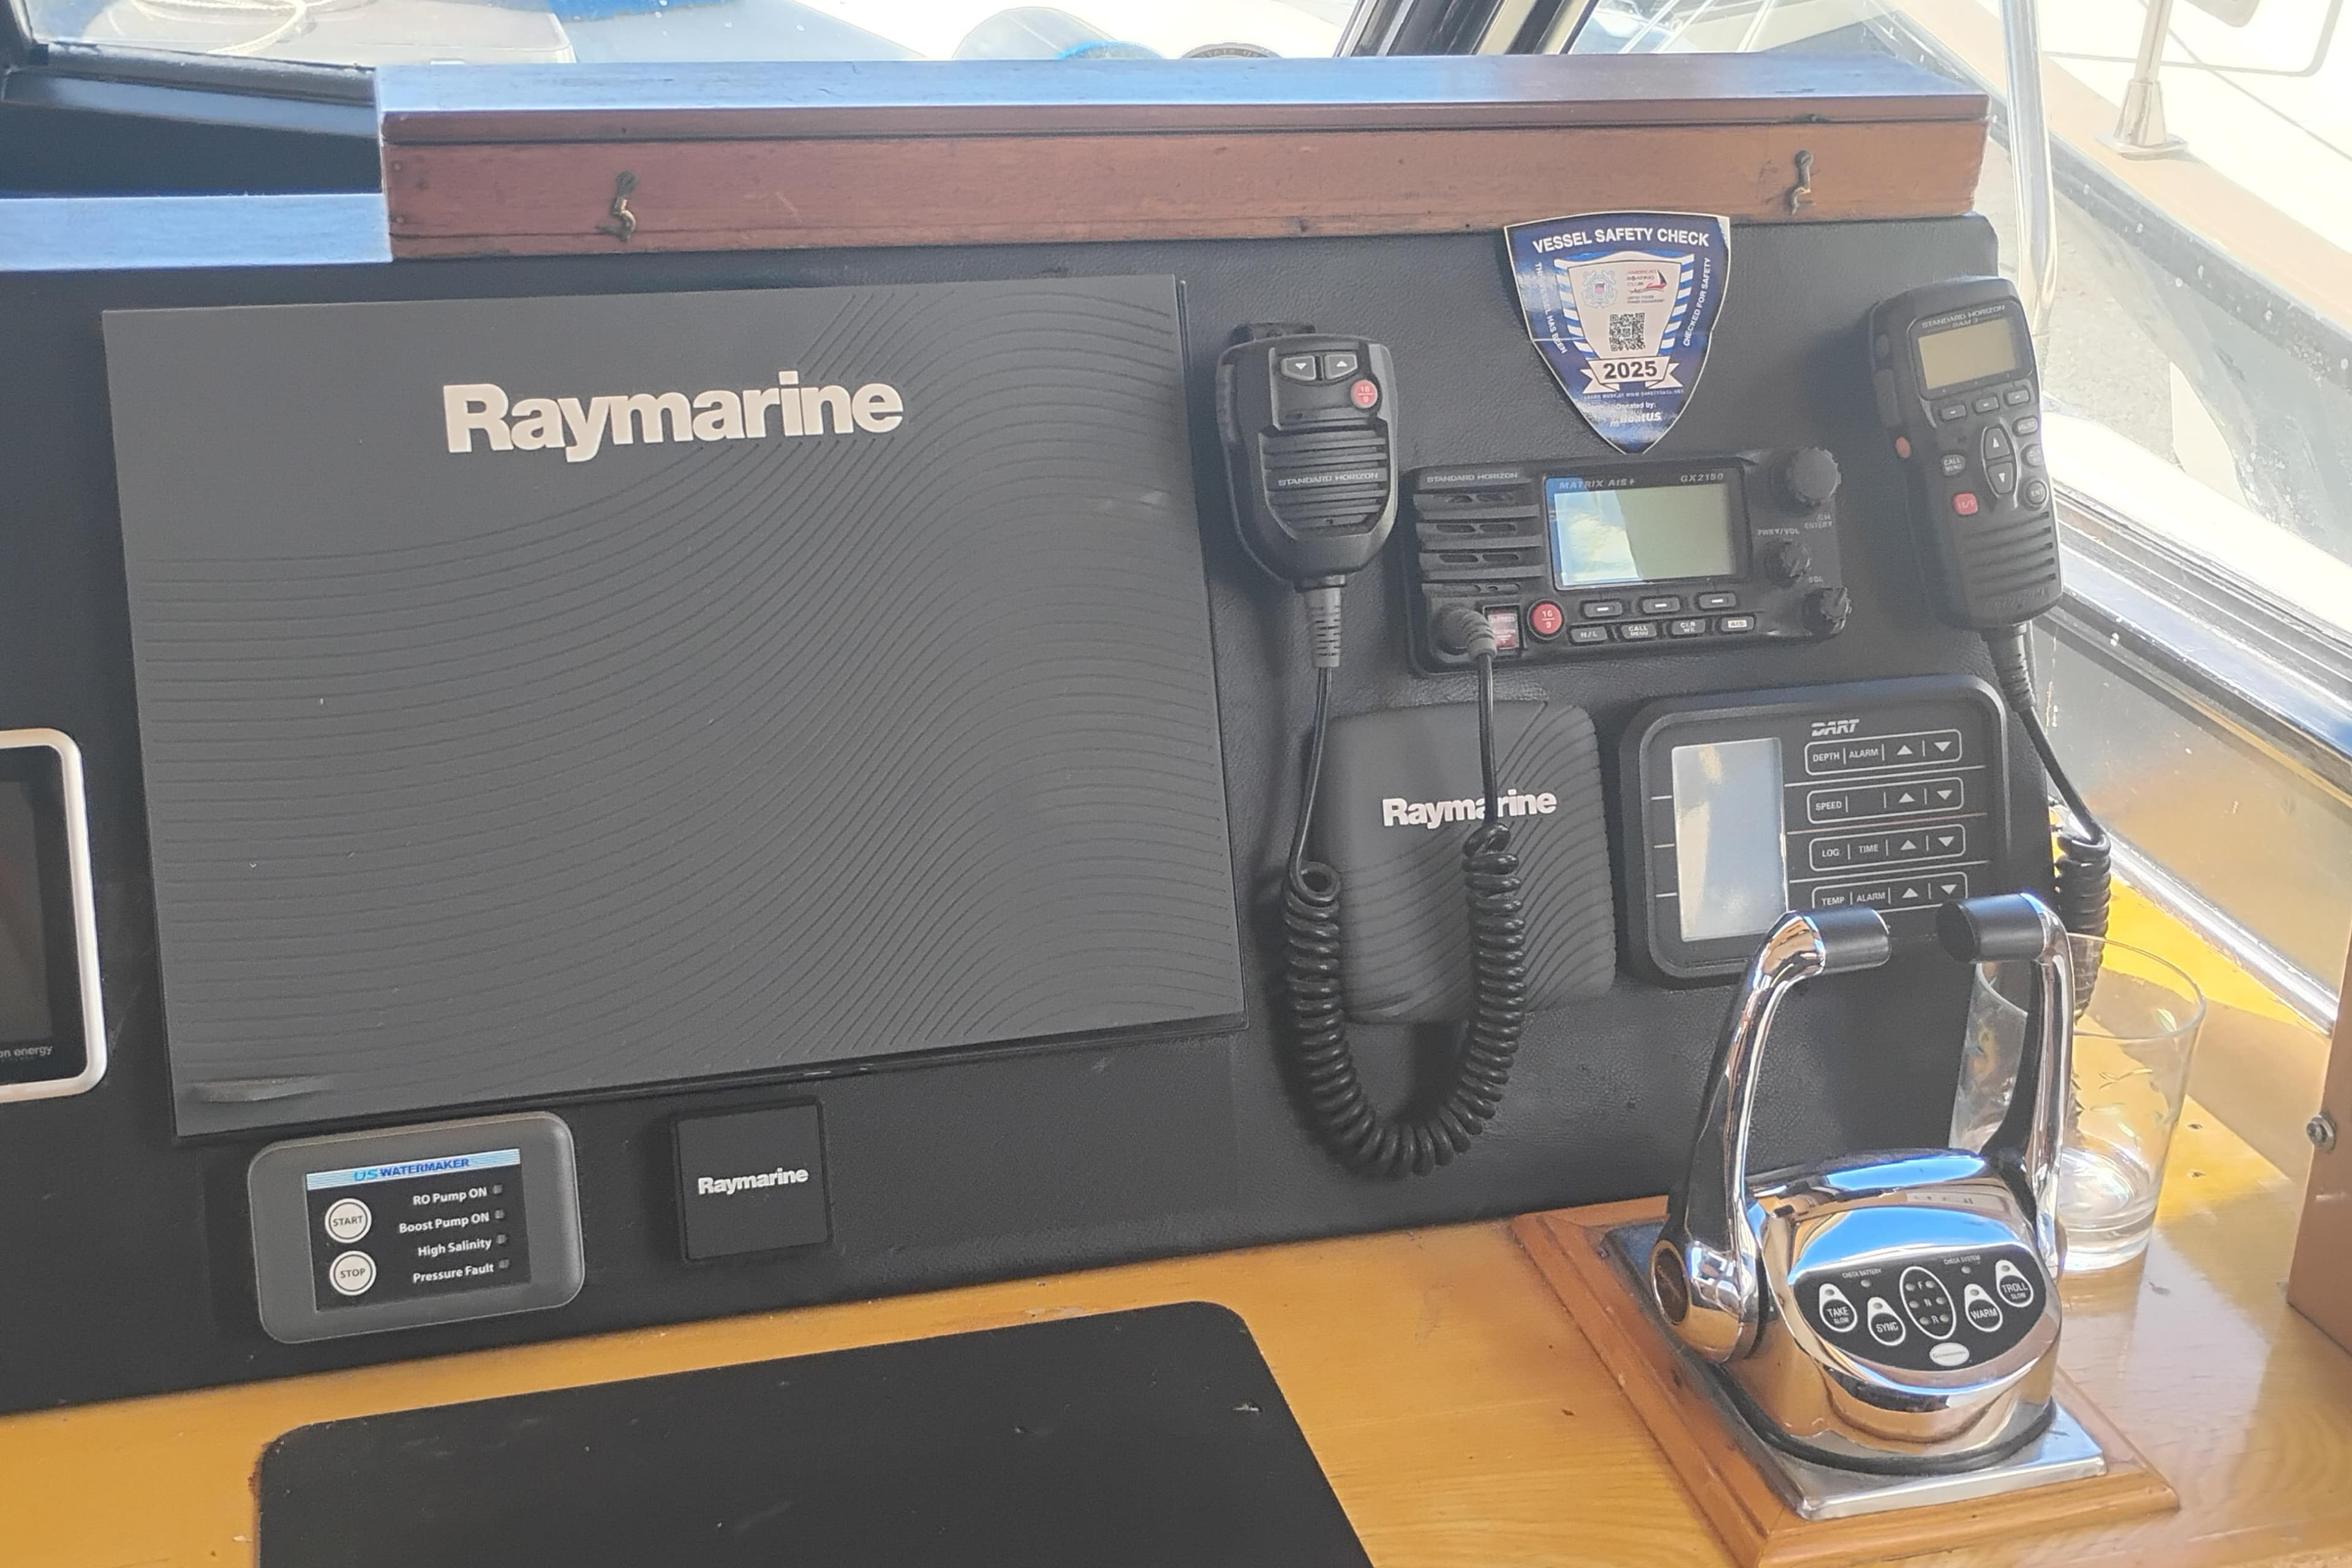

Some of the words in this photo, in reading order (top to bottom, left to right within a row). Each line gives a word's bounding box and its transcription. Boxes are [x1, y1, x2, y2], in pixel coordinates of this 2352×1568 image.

[1532, 232, 1592, 254] VESSEL
[1594, 227, 1653, 243] SAFETY
[1656, 228, 1710, 247] CHECK
[1683, 309, 1701, 347] CHECKED
[1696, 290, 1707, 309] FOR
[1702, 257, 1712, 291] SAFETY
[1921, 313, 1966, 329] STANDARD
[1967, 304, 2006, 318] HORIZON
[1547, 315, 1557, 333] HAS
[1551, 332, 1568, 354] BEEN
[1603, 360, 1657, 380] 2025
[443, 370, 904, 463] Raymarine
[1943, 457, 1961, 466] CALL
[1278, 475, 1332, 486] STANDARD
[1335, 472, 1378, 481] HORIZON
[1427, 474, 1475, 483] STANDARD
[1477, 472, 1518, 481] HORIZON
[1558, 479, 1604, 489] MATRIX
[1608, 477, 1637, 487] AIS+
[1542, 609, 1553, 618] 16
[1811, 718, 1860, 737] DART
[1812, 750, 1840, 763] DEPTH
[1848, 747, 1879, 760] ALARM
[1815, 800, 1842, 812] SPEED
[1821, 846, 1840, 858] LOG
[1858, 843, 1879, 854] TIME
[1821, 894, 1845, 907] TEMP
[1856, 891, 1886, 903] ALARM
[14, 1046, 53, 1057] energy
[352, 1167, 379, 1182] US
[380, 1158, 470, 1177] WATERMAKER
[698, 1167, 809, 1195] Raymarine
[412, 1194, 431, 1207] RO
[432, 1191, 467, 1206] Pump
[469, 1186, 488, 1199] ON
[333, 1215, 364, 1227] START
[399, 1221, 433, 1234] Boost
[435, 1216, 469, 1231] Pump
[471, 1211, 490, 1224] ON
[418, 1245, 446, 1259] High
[447, 1238, 492, 1254] Salinity
[1961, 1254, 1981, 1263] SYSTEM
[339, 1267, 366, 1279] STOP
[413, 1268, 463, 1284] Pressure
[464, 1262, 495, 1277] Fault
[1859, 1268, 1882, 1277] BATTERY
[1917, 1281, 1923, 1289] F
[2002, 1283, 2029, 1294] TROLL
[1923, 1298, 1932, 1308] N
[1826, 1306, 1849, 1317] TAKE
[1970, 1308, 1998, 1320] WARM
[1931, 1315, 1939, 1324] R
[1875, 1322, 1899, 1333] SYNC
